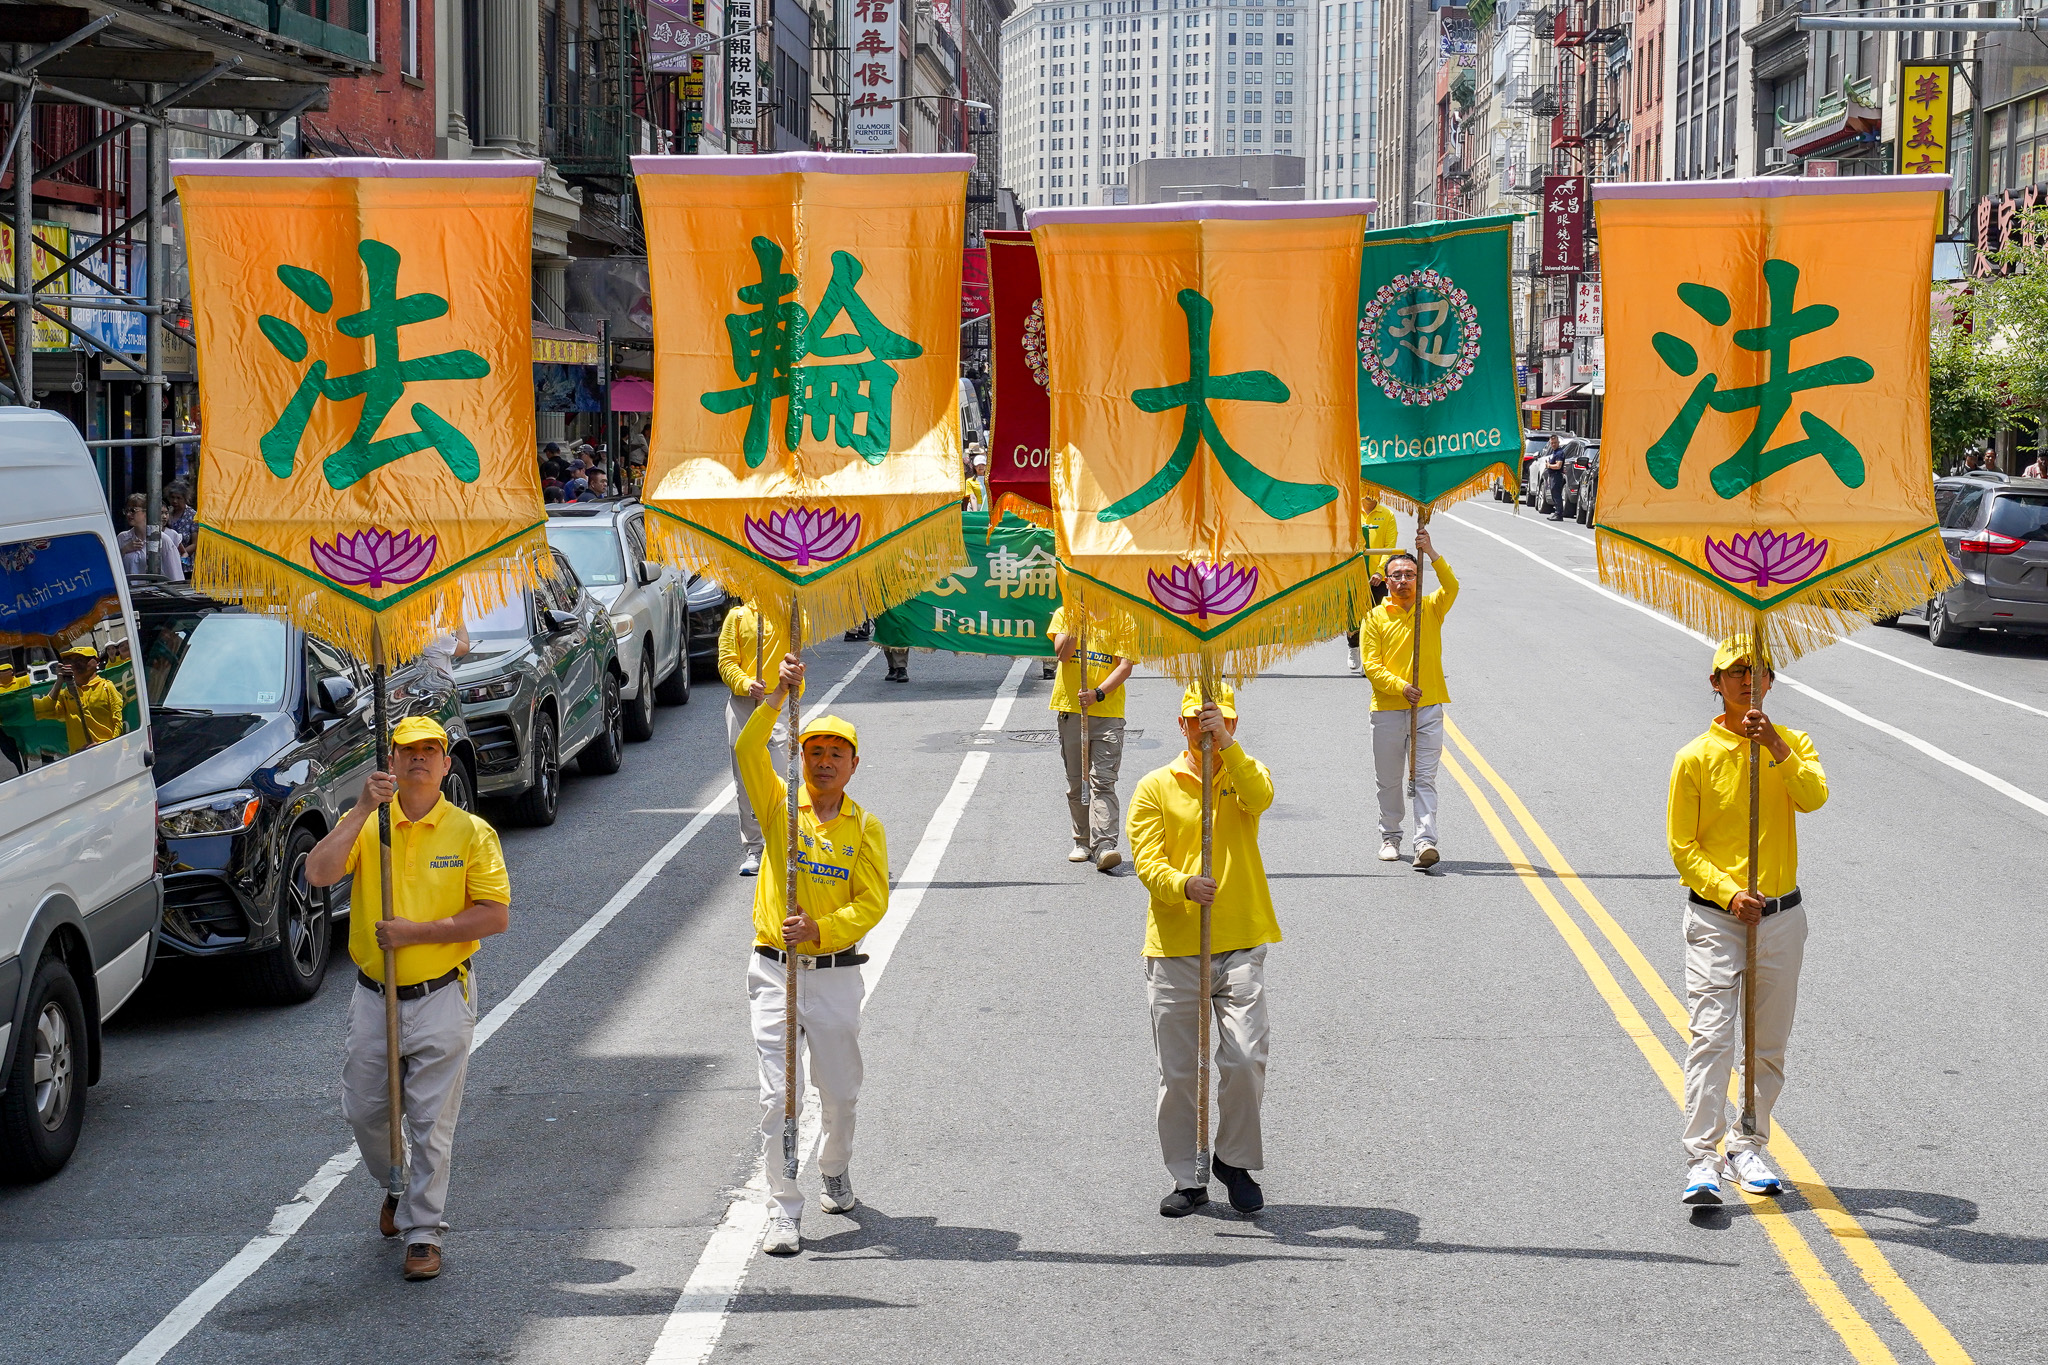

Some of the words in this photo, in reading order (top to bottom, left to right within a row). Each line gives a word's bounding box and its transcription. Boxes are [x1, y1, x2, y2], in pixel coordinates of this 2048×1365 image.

[1548, 196, 1580, 214] 永昌
[1556, 213, 1571, 263] 眼鏡公司
[700, 236, 923, 469] 輪
[1383, 299, 1458, 368] 忍
[257, 239, 491, 490] 法
[1646, 258, 1875, 500] 法
[1097, 288, 1339, 522] 大
[931, 605, 1037, 639] Falun
[430, 860, 449, 869] FALUN
[450, 860, 464, 868] DAFA
[817, 865, 845, 879] DAFA
